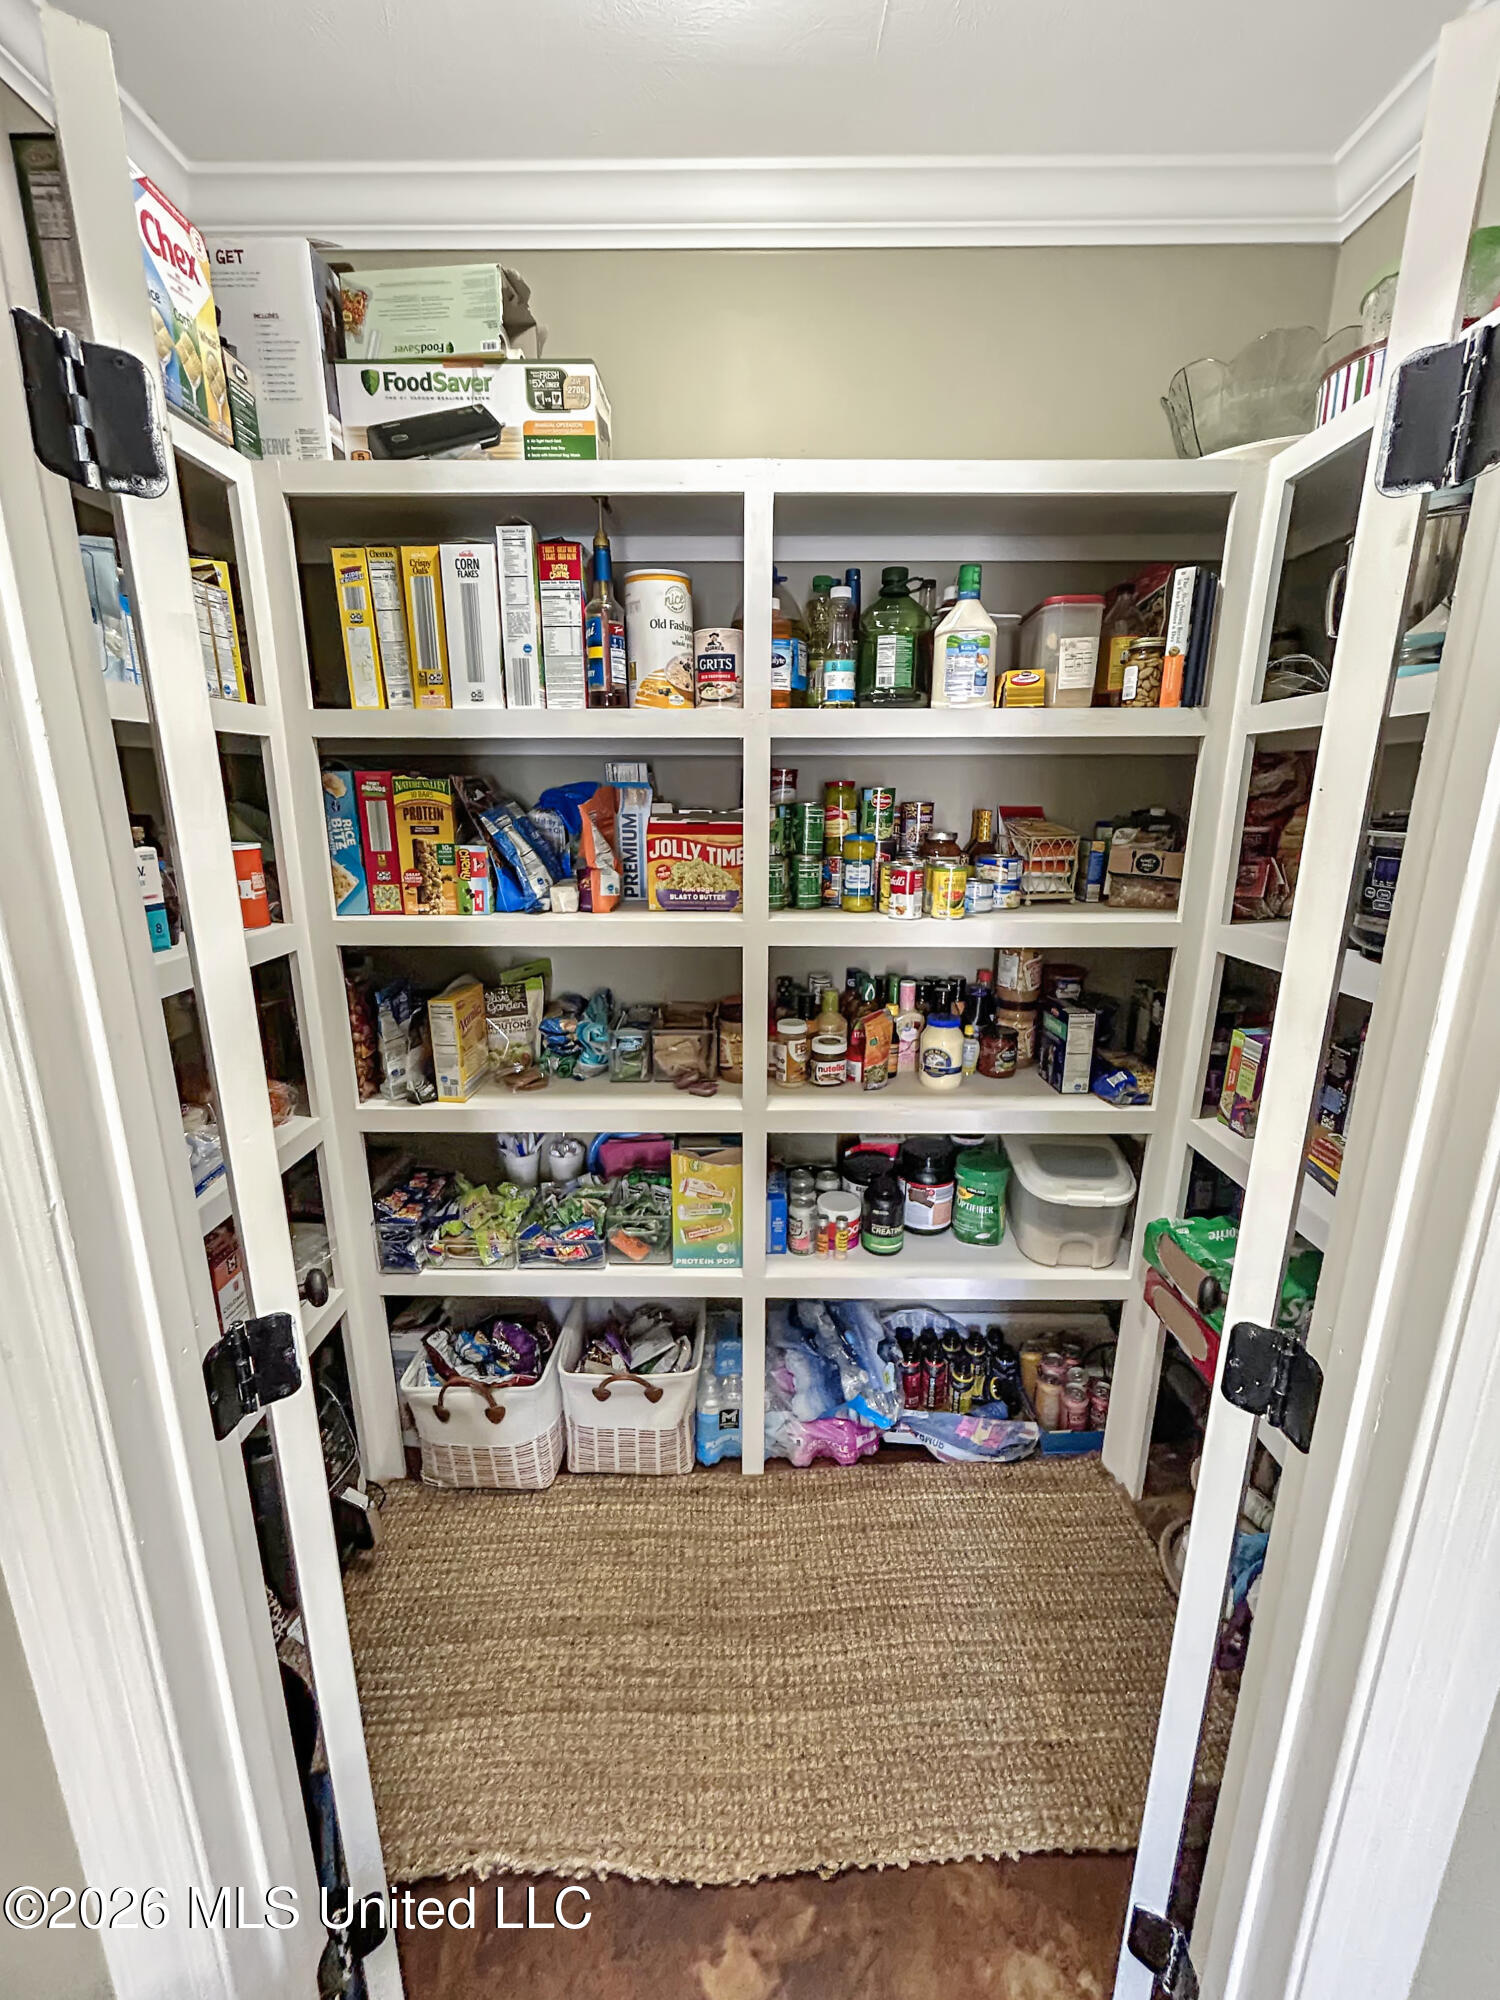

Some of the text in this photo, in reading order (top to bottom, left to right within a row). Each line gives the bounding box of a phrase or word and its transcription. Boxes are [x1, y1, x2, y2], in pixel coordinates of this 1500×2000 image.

[140, 209, 202, 287] Chex
[216, 250, 244, 265] GET
[393, 342, 444, 354] FoodSaver
[382, 371, 494, 393] FoodSaver
[539, 371, 560, 380] FRESH
[409, 558, 431, 568] Crispy
[454, 558, 480, 570] CORN
[457, 570, 479, 578] FLAKES
[1172, 601, 1180, 625] Minutes
[649, 618, 666, 629] Old
[1175, 626, 1183, 644] Bread
[700, 658, 733, 670] GRITS
[395, 779, 422, 792] NATURE
[422, 779, 447, 792] VALLEY
[402, 805, 444, 821] PROTEIN
[622, 813, 639, 898] PREMIUM
[649, 838, 743, 867] JOLLY TIME
[486, 1000, 527, 1014] Garden
[487, 1020, 532, 1031] ROUTONS
[818, 1063, 845, 1073] nutella
[1208, 1226, 1237, 1242] prite
[676, 1257, 714, 1265] PROTEIN
